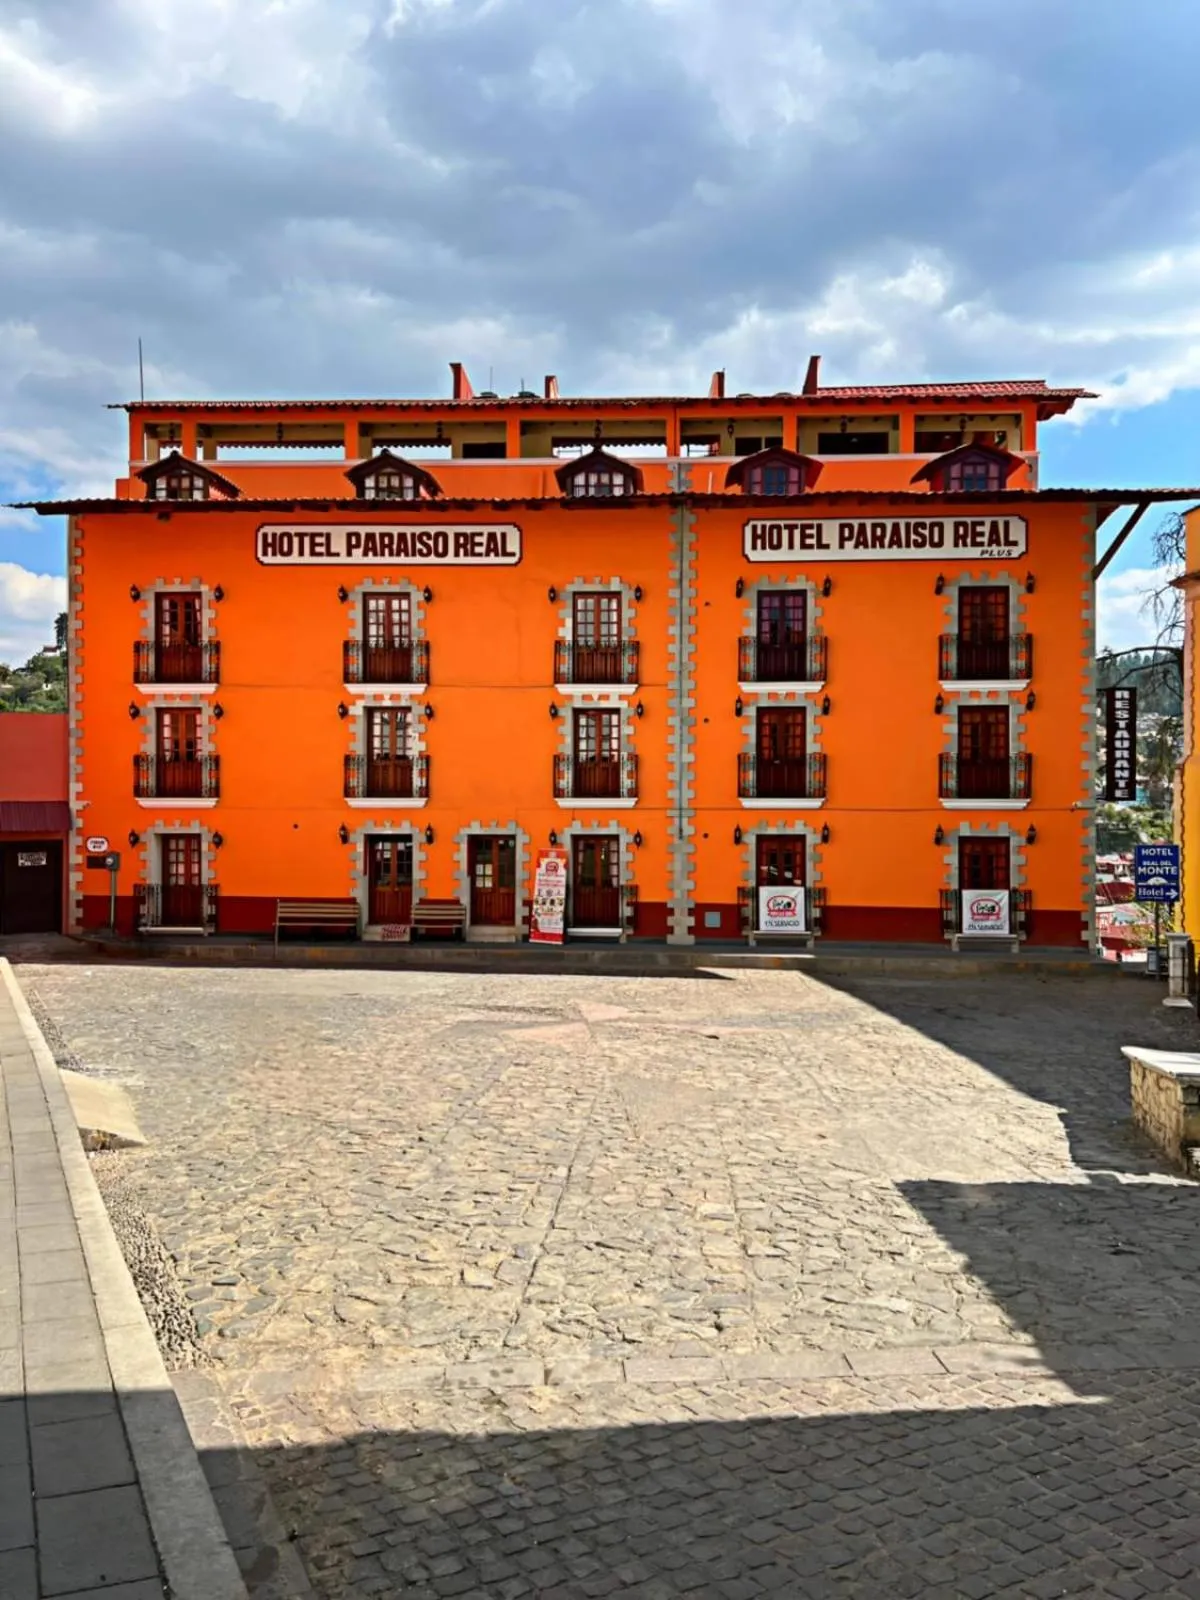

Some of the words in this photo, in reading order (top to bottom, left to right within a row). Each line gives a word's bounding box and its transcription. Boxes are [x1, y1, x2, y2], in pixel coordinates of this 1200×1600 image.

[751, 522, 831, 551] HOTEL
[838, 521, 944, 550] PARAISO
[953, 520, 1019, 548] REAL
[261, 532, 340, 557] HOTEL
[346, 531, 449, 558] PARAISO
[453, 532, 516, 557] REAL
[979, 549, 1013, 557] PLUS
[1114, 690, 1130, 798] RESTAURANTE
[1141, 848, 1173, 856] HOTEL
[1138, 866, 1178, 875] MONTE
[1138, 887, 1164, 896] Hotel
